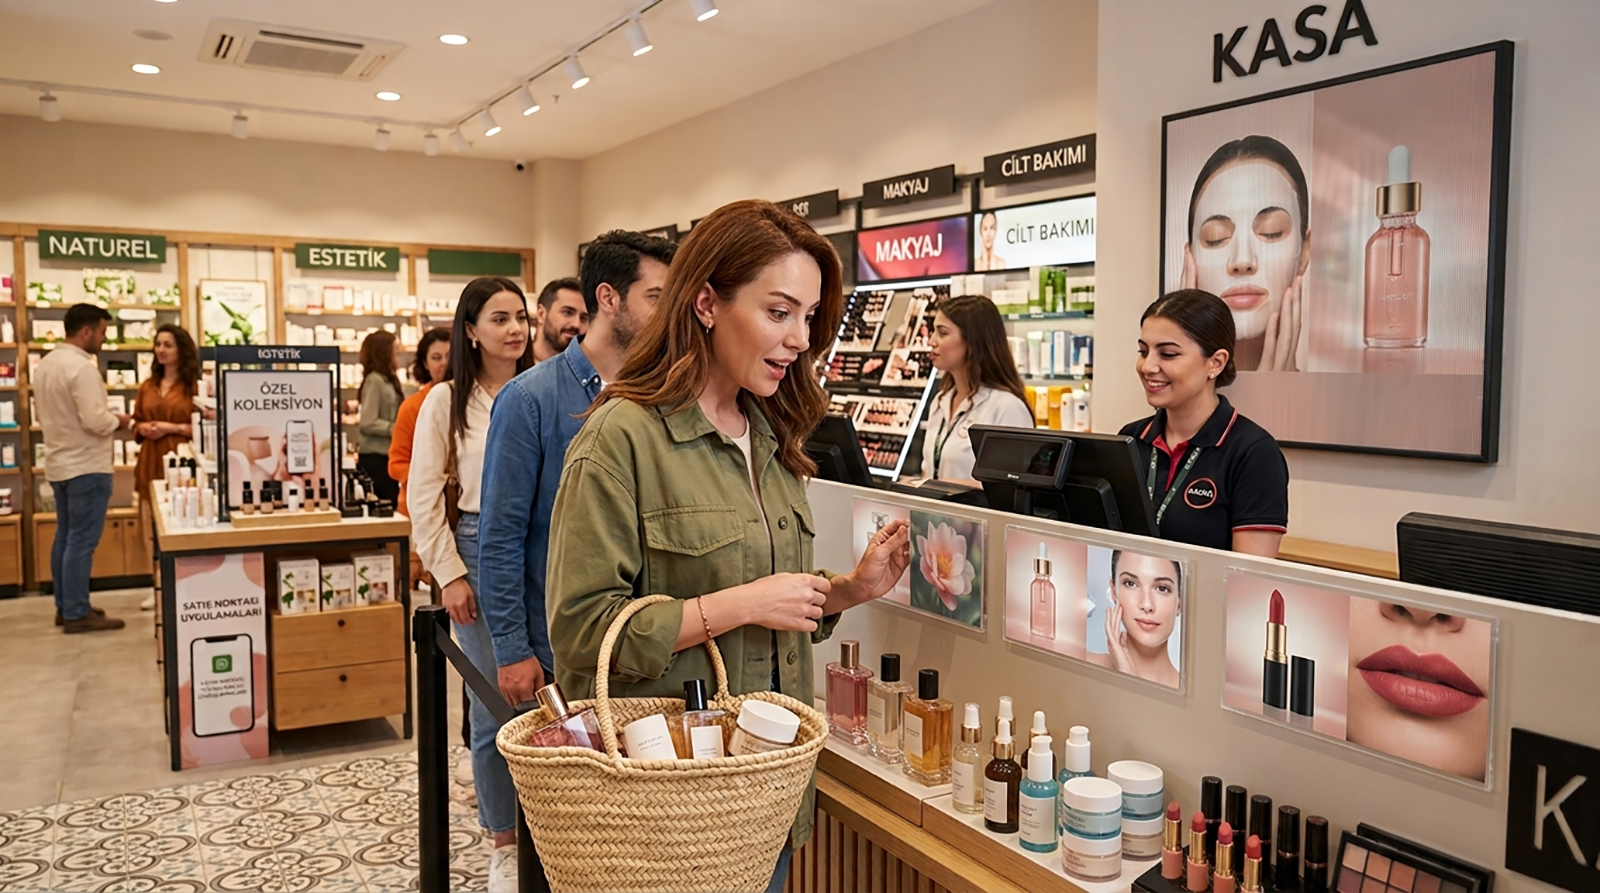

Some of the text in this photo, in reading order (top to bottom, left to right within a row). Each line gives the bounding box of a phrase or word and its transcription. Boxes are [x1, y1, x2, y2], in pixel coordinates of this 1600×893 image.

[1213, 0, 1378, 83] KASA
[1001, 144, 1087, 177] CİLT BAKIMI
[883, 177, 929, 200] MAKYAJ
[1006, 218, 1094, 245] CİLT BAKIMI
[49, 235, 159, 259] NATUREL
[309, 247, 387, 269] ESTETİK
[876, 232, 943, 263] MAKYAJ
[260, 381, 297, 395] ÖZEL
[1533, 763, 1600, 870] K
